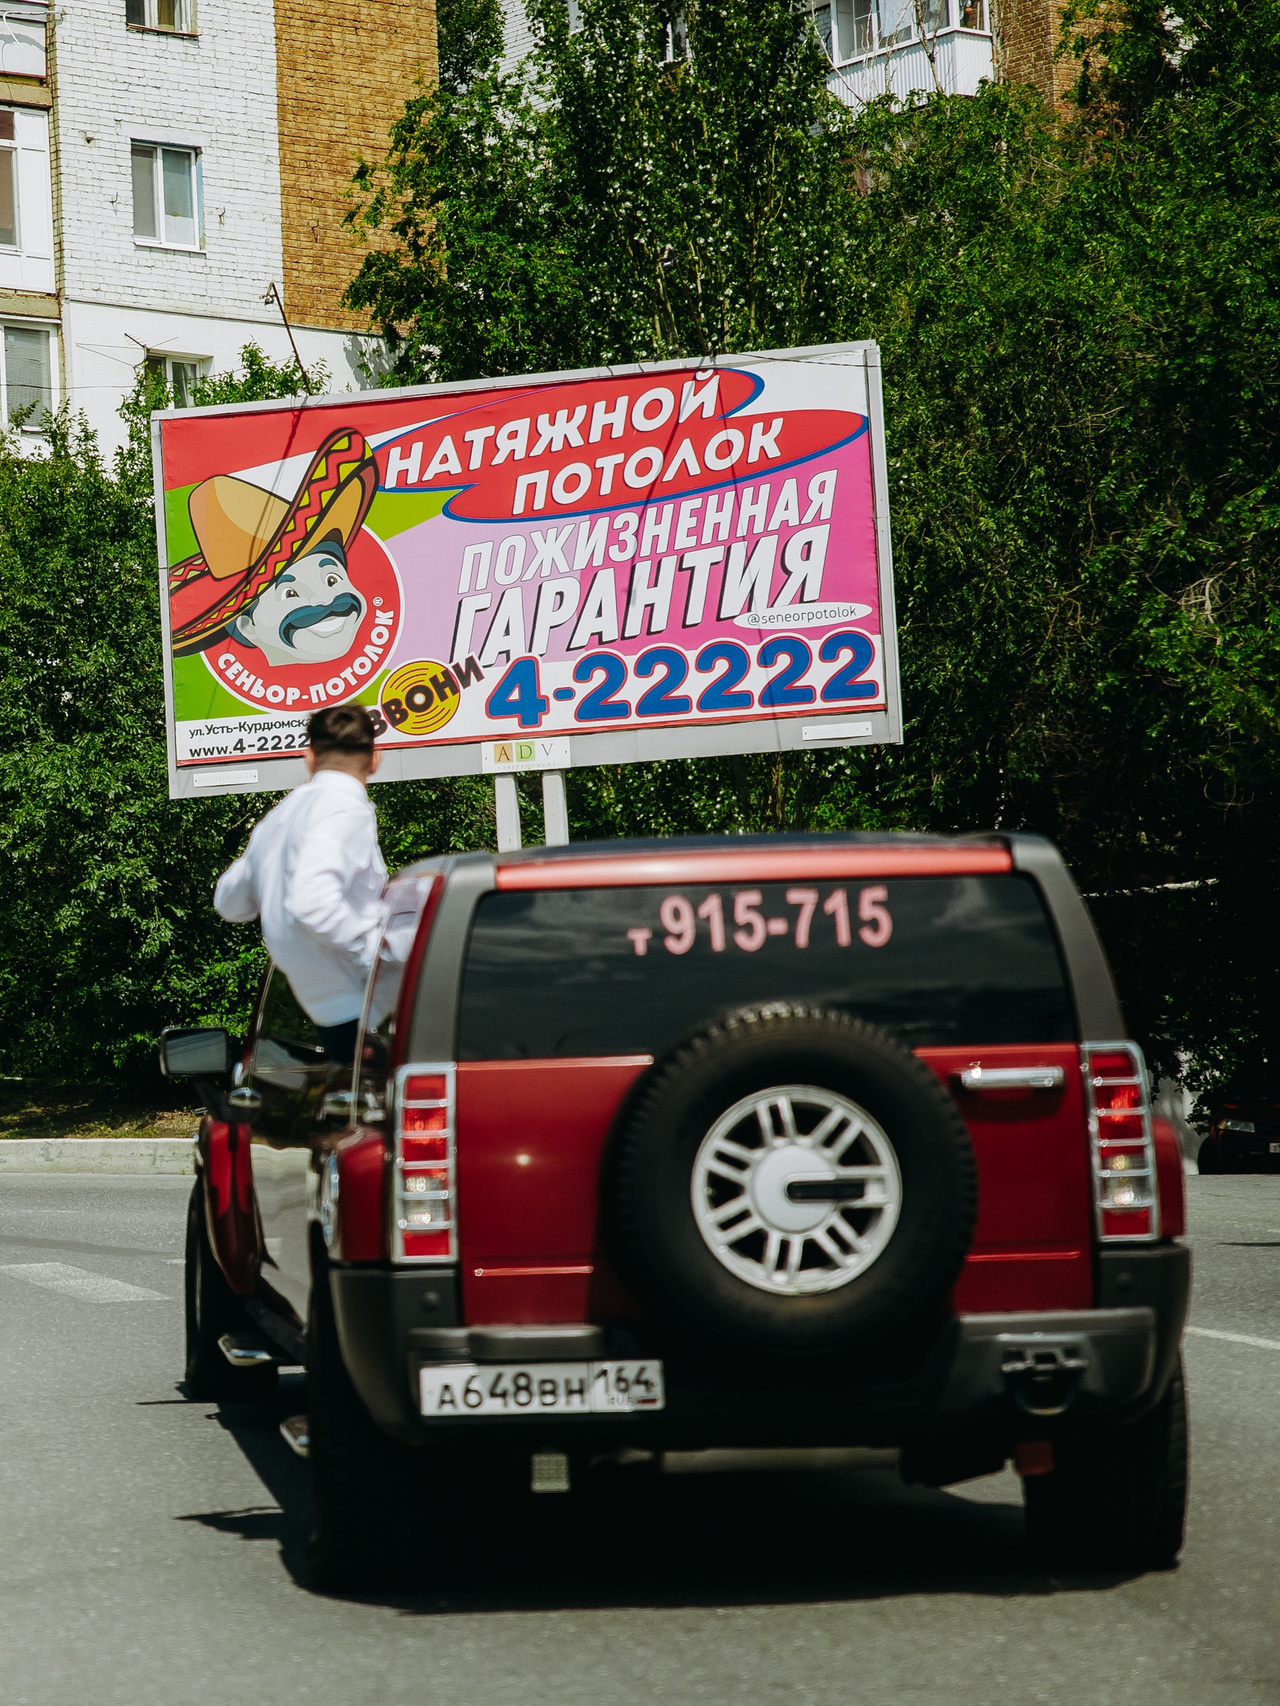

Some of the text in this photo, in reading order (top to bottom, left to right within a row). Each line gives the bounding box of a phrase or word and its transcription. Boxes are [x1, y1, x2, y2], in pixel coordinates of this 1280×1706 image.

[384, 368, 720, 489] НАТЯЖНОЙ
[512, 417, 785, 515] ПОТОЛОК
[457, 468, 838, 595] ПОЖИЗНЕННАЯ
[450, 523, 832, 668] ГАРАНТИЯ
[747, 605, 857, 626] @seneorpotolok
[485, 630, 879, 729] 4-22222
[660, 884, 893, 955] 915-715
[437, 1366, 655, 1410] А648ВН 164
